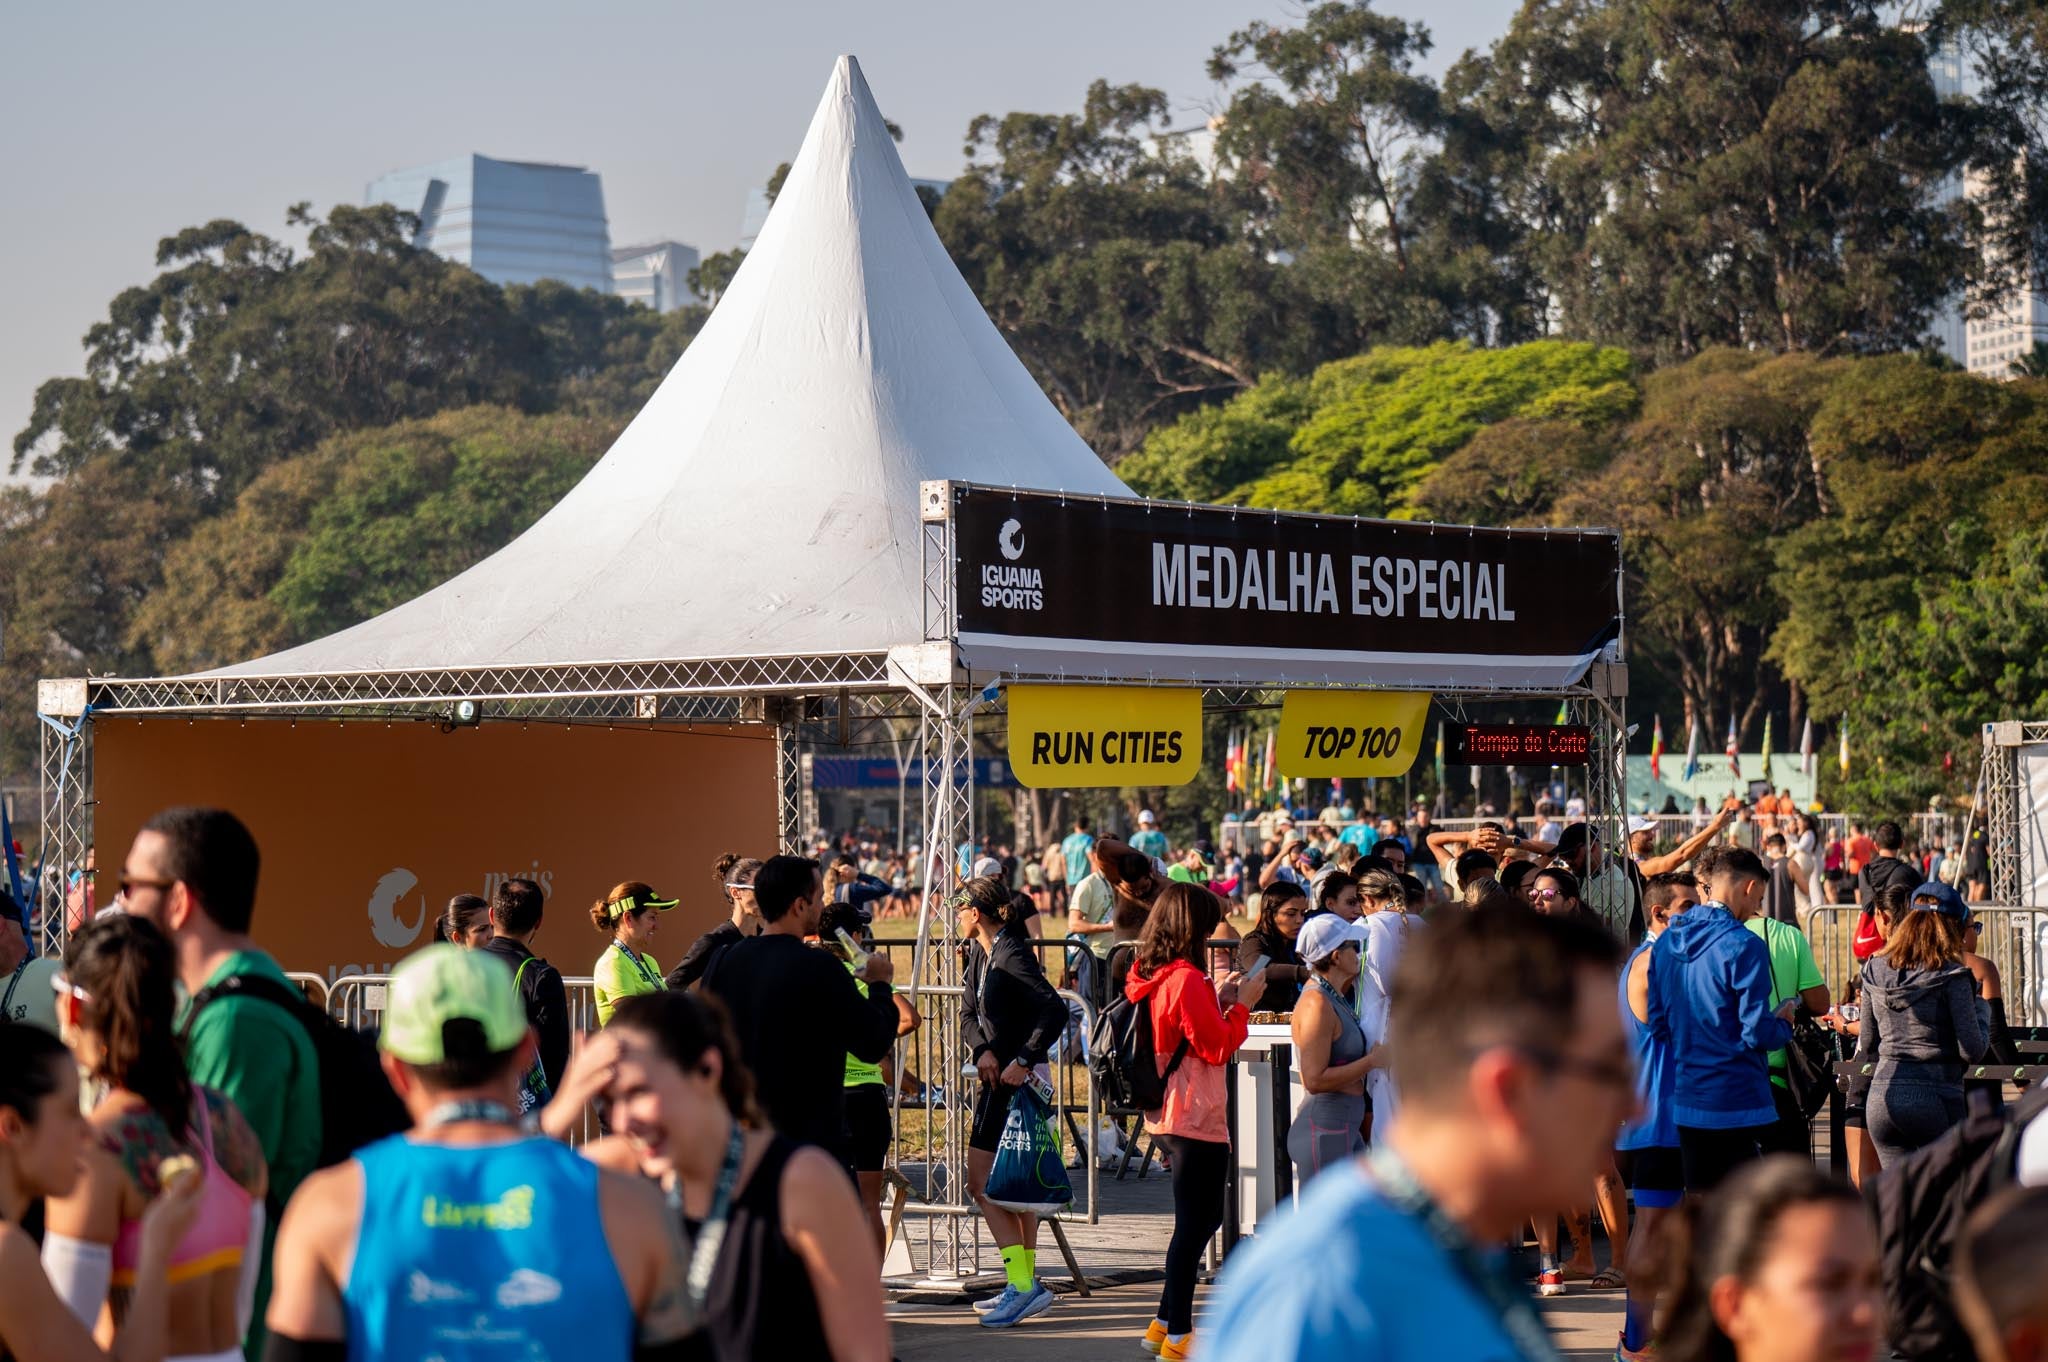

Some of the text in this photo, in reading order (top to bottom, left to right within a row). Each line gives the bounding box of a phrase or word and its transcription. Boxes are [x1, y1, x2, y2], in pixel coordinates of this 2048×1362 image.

[981, 564, 1043, 589] IGUANA
[1152, 542, 1515, 621] MEDALHA ESPECIAL
[981, 586, 1043, 611] SPORTS
[1032, 731, 1183, 765] RUN CITIES
[1304, 726, 1402, 759] TOP 100
